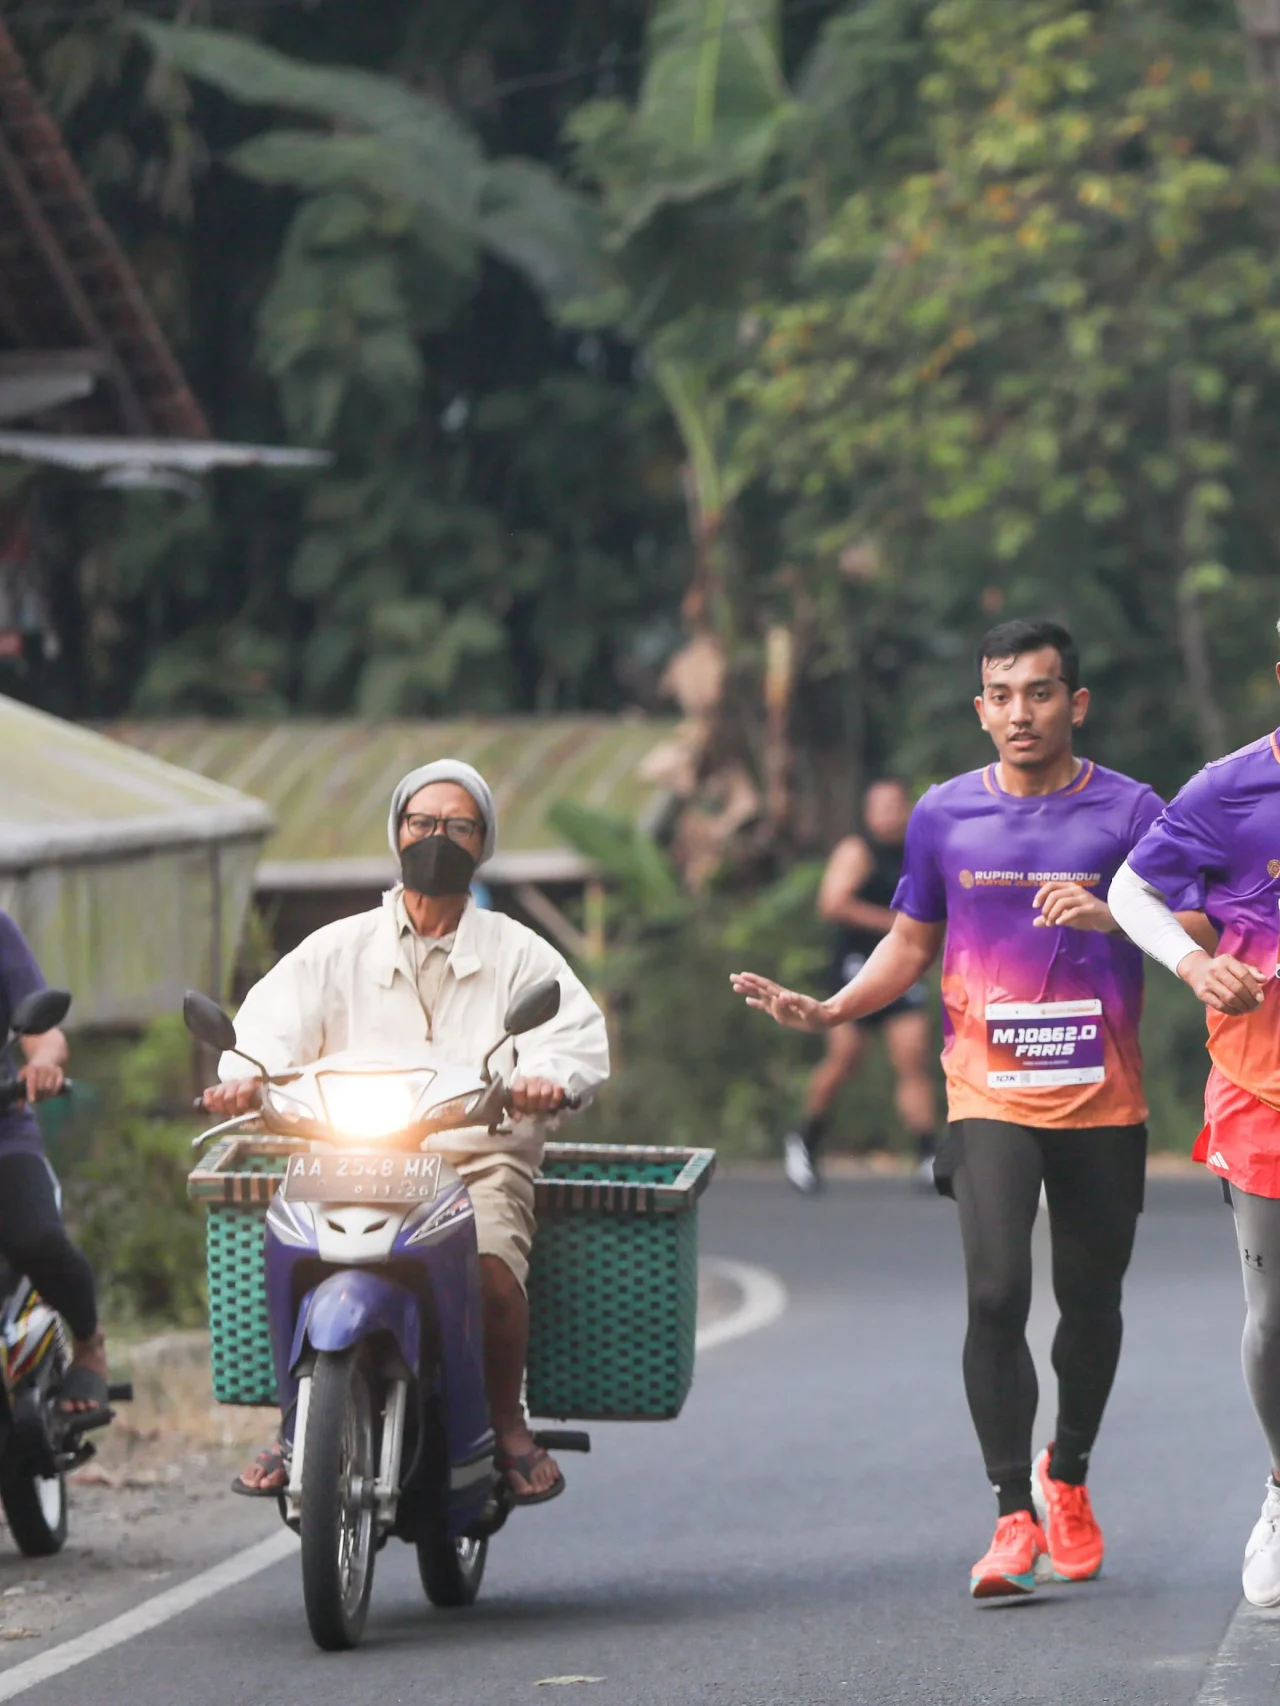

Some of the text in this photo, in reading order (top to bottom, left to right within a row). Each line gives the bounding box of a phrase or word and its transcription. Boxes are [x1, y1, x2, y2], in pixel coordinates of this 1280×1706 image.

[974, 870, 1101, 882] RUPIAH BOROBUDUR
[1014, 1042, 1076, 1057] FARIS
[292, 1157, 437, 1178] AA 2548 MK
